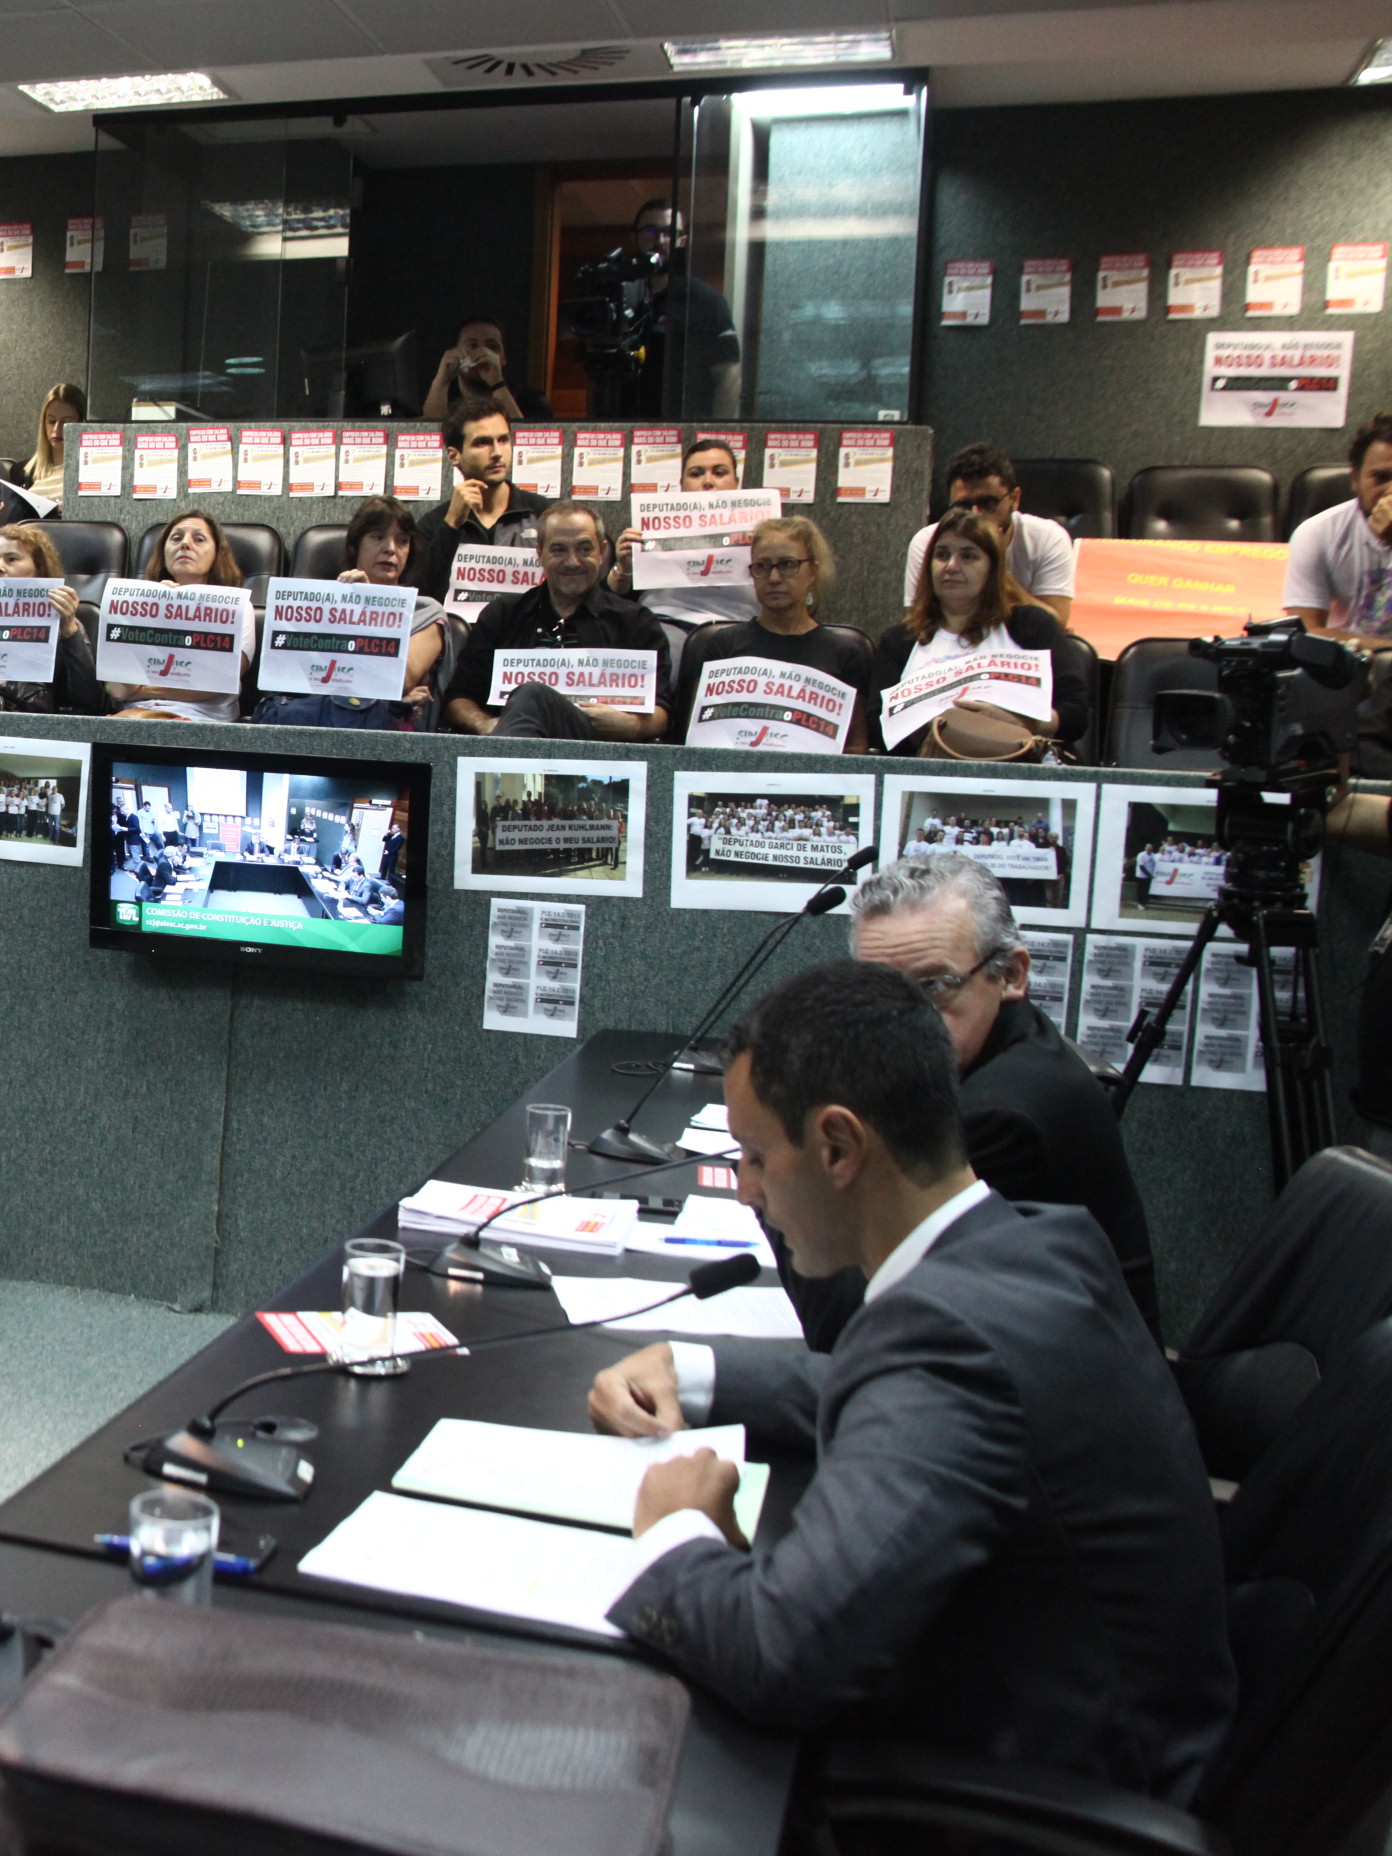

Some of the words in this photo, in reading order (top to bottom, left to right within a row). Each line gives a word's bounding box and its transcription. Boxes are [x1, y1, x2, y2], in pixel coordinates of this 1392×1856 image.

[1213, 354, 1263, 368] NOSSO
[640, 502, 705, 513] DEPUTADO(A),
[708, 499, 728, 509] NÃO
[731, 497, 772, 508] NEGOCIE
[641, 516, 692, 531] NOSSO
[699, 509, 771, 528] SALÁRIO!
[1204, 542, 1289, 560] EMPREGO
[457, 553, 519, 568] DEPUTADO(A),
[522, 556, 541, 568] NÃO
[456, 566, 506, 584] NOSSO
[1127, 573, 1169, 586] QUER
[1172, 577, 1237, 594] GANHAR
[17, 588, 49, 598] NEGOCI
[111, 587, 174, 601] DEPUTADO(A),
[177, 590, 196, 601] NÃO
[198, 593, 240, 605] NEGOCIE
[275, 590, 338, 605] DEPUTADO(A),
[341, 593, 361, 605] NÃO
[364, 596, 407, 608] NEGOCIE
[109, 600, 159, 618] NOSSO
[164, 603, 236, 624] SALÁRIO!
[274, 605, 323, 623] NOSSO
[328, 607, 403, 628] SALÁRIO!
[110, 627, 230, 649] #VoteContraoPLC14
[274, 634, 396, 654] #VoteContraoPLC14
[503, 658, 574, 669] DEPUTADO(A),
[577, 656, 598, 668] NÃO
[602, 658, 648, 670] NEGOCIE
[965, 655, 987, 665] NÃO
[991, 653, 1040, 661] NEGOCIE
[502, 671, 559, 686] NOSSO
[565, 668, 645, 688] SALÁRIO!
[708, 666, 775, 679] DEPUTADO(A),
[779, 670, 801, 683] NÃO
[804, 676, 847, 700] NEGOCIE
[889, 676, 947, 702] NOSSO
[953, 658, 1040, 678] SALÁRIO!
[704, 679, 758, 697] NOSSO
[763, 681, 843, 716] SALÁRIO!
[702, 704, 835, 735] #VoteContraoPLC14
[502, 823, 544, 833] DEPUTADO
[546, 823, 566, 832] JEAN
[498, 835, 516, 846] NÃO
[518, 836, 553, 846] NEGOCIE
[555, 836, 561, 845] O
[563, 836, 579, 845] MEU
[796, 843, 807, 852] DE
[811, 844, 847, 855] MATOS,
[714, 847, 731, 858] NÃO
[734, 850, 769, 862] NEGOCIE
[772, 853, 800, 864] NOSSO
[145, 907, 188, 919] COMISSÃO
[189, 911, 200, 920] DE
[202, 912, 262, 927] CONSTITUIÇÃO
[263, 918, 269, 926] E
[269, 919, 304, 931] JUSTIÇA
[145, 919, 207, 931] ccj@alesc.sc.gov.br
[240, 946, 263, 954] SONY
